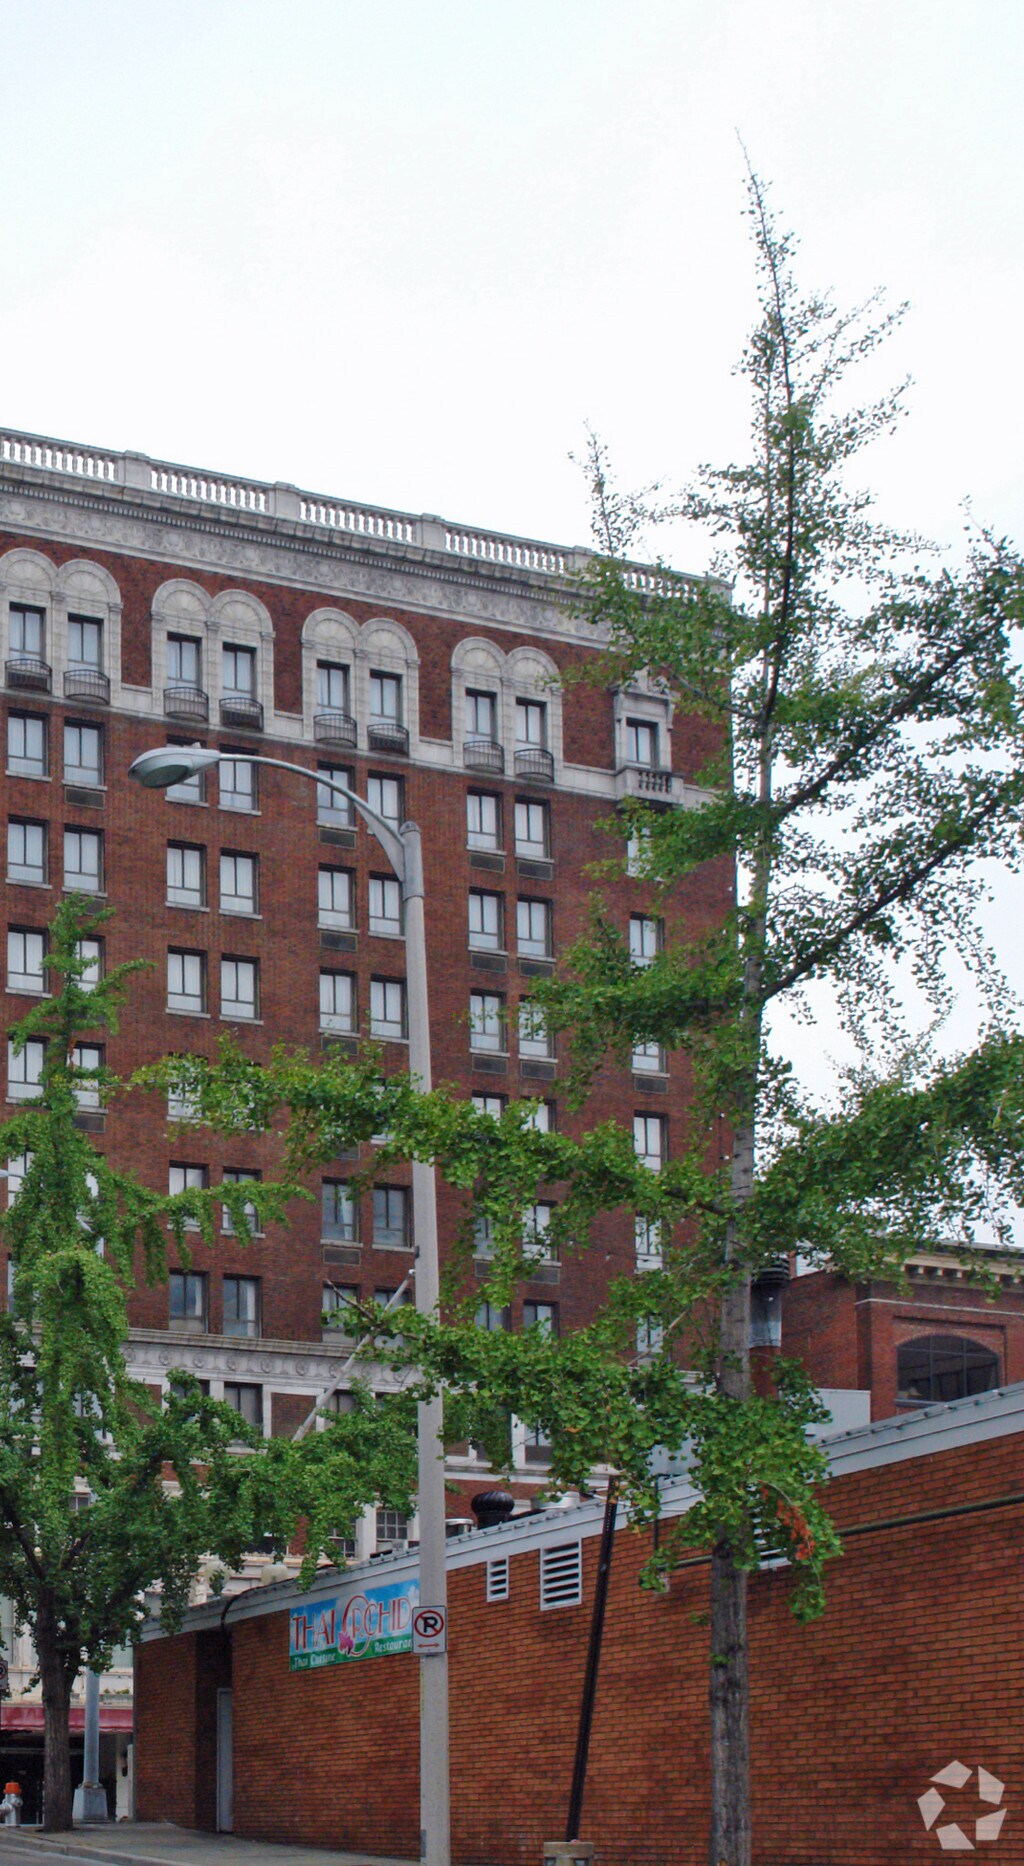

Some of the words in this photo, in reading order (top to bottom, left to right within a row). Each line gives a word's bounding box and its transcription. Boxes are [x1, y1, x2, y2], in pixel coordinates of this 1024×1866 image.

[292, 1608, 336, 1651] THAI
[341, 1595, 412, 1656] ORCHID
[374, 1638, 413, 1653] Restauran
